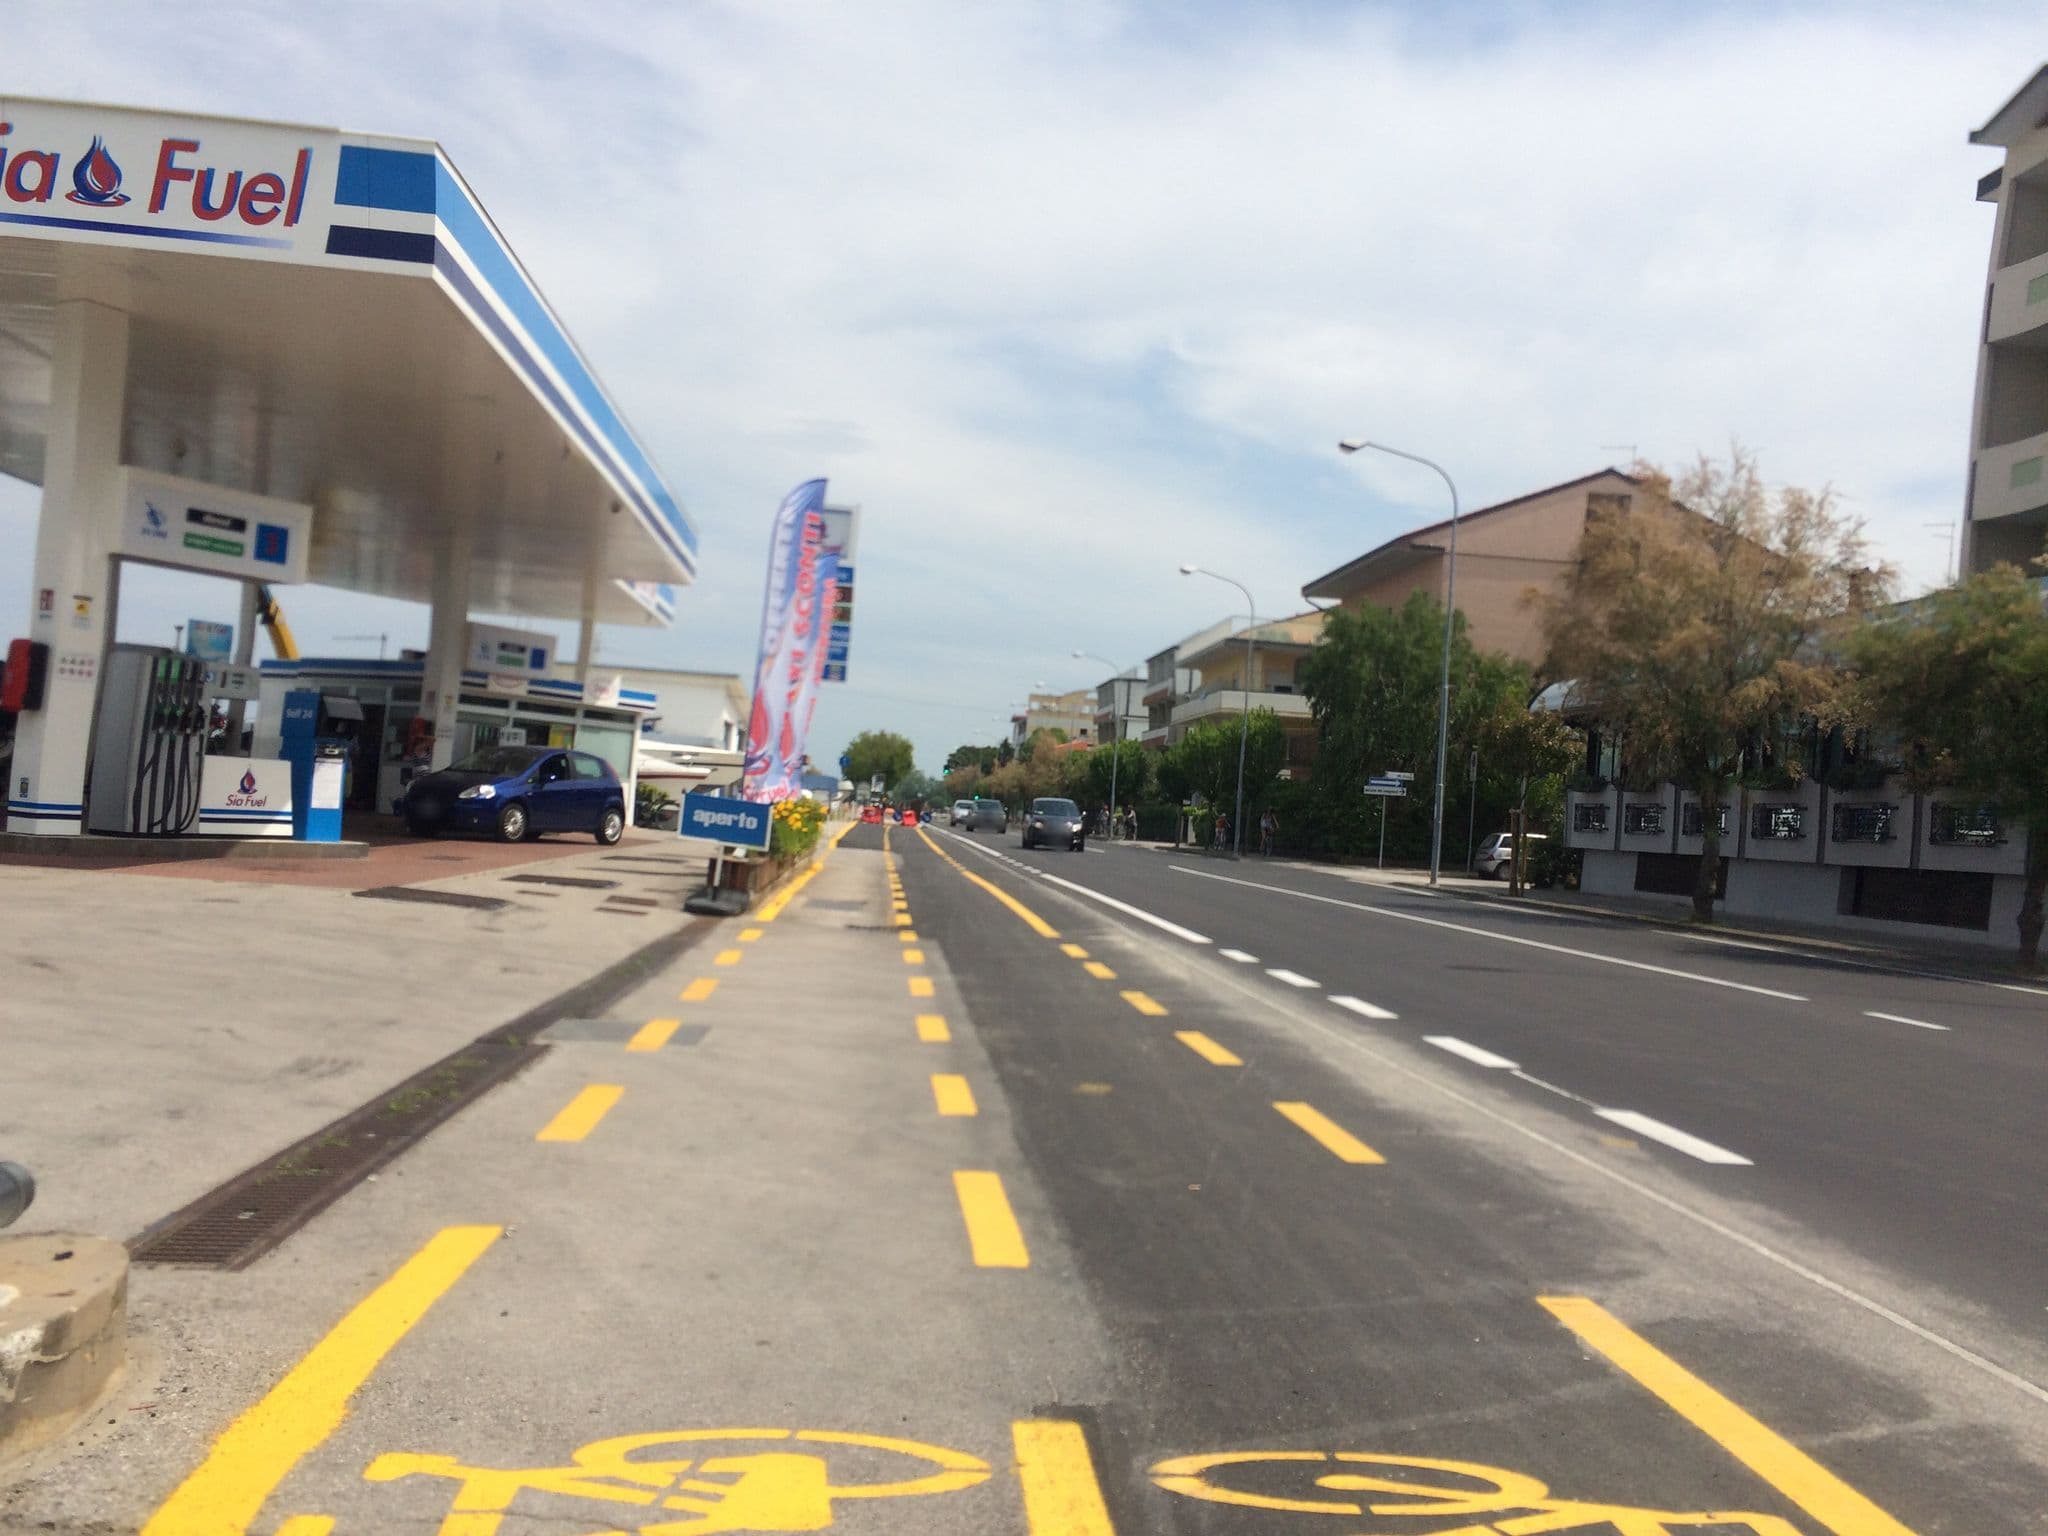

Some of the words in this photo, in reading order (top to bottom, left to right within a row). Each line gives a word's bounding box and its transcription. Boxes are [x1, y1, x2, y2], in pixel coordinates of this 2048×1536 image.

[0, 122, 60, 203] ia
[148, 138, 312, 227] Fuel
[793, 511, 822, 638] SCONTI
[226, 794, 244, 807] Sia
[245, 795, 268, 808] Fuel
[693, 809, 758, 830] aperto
